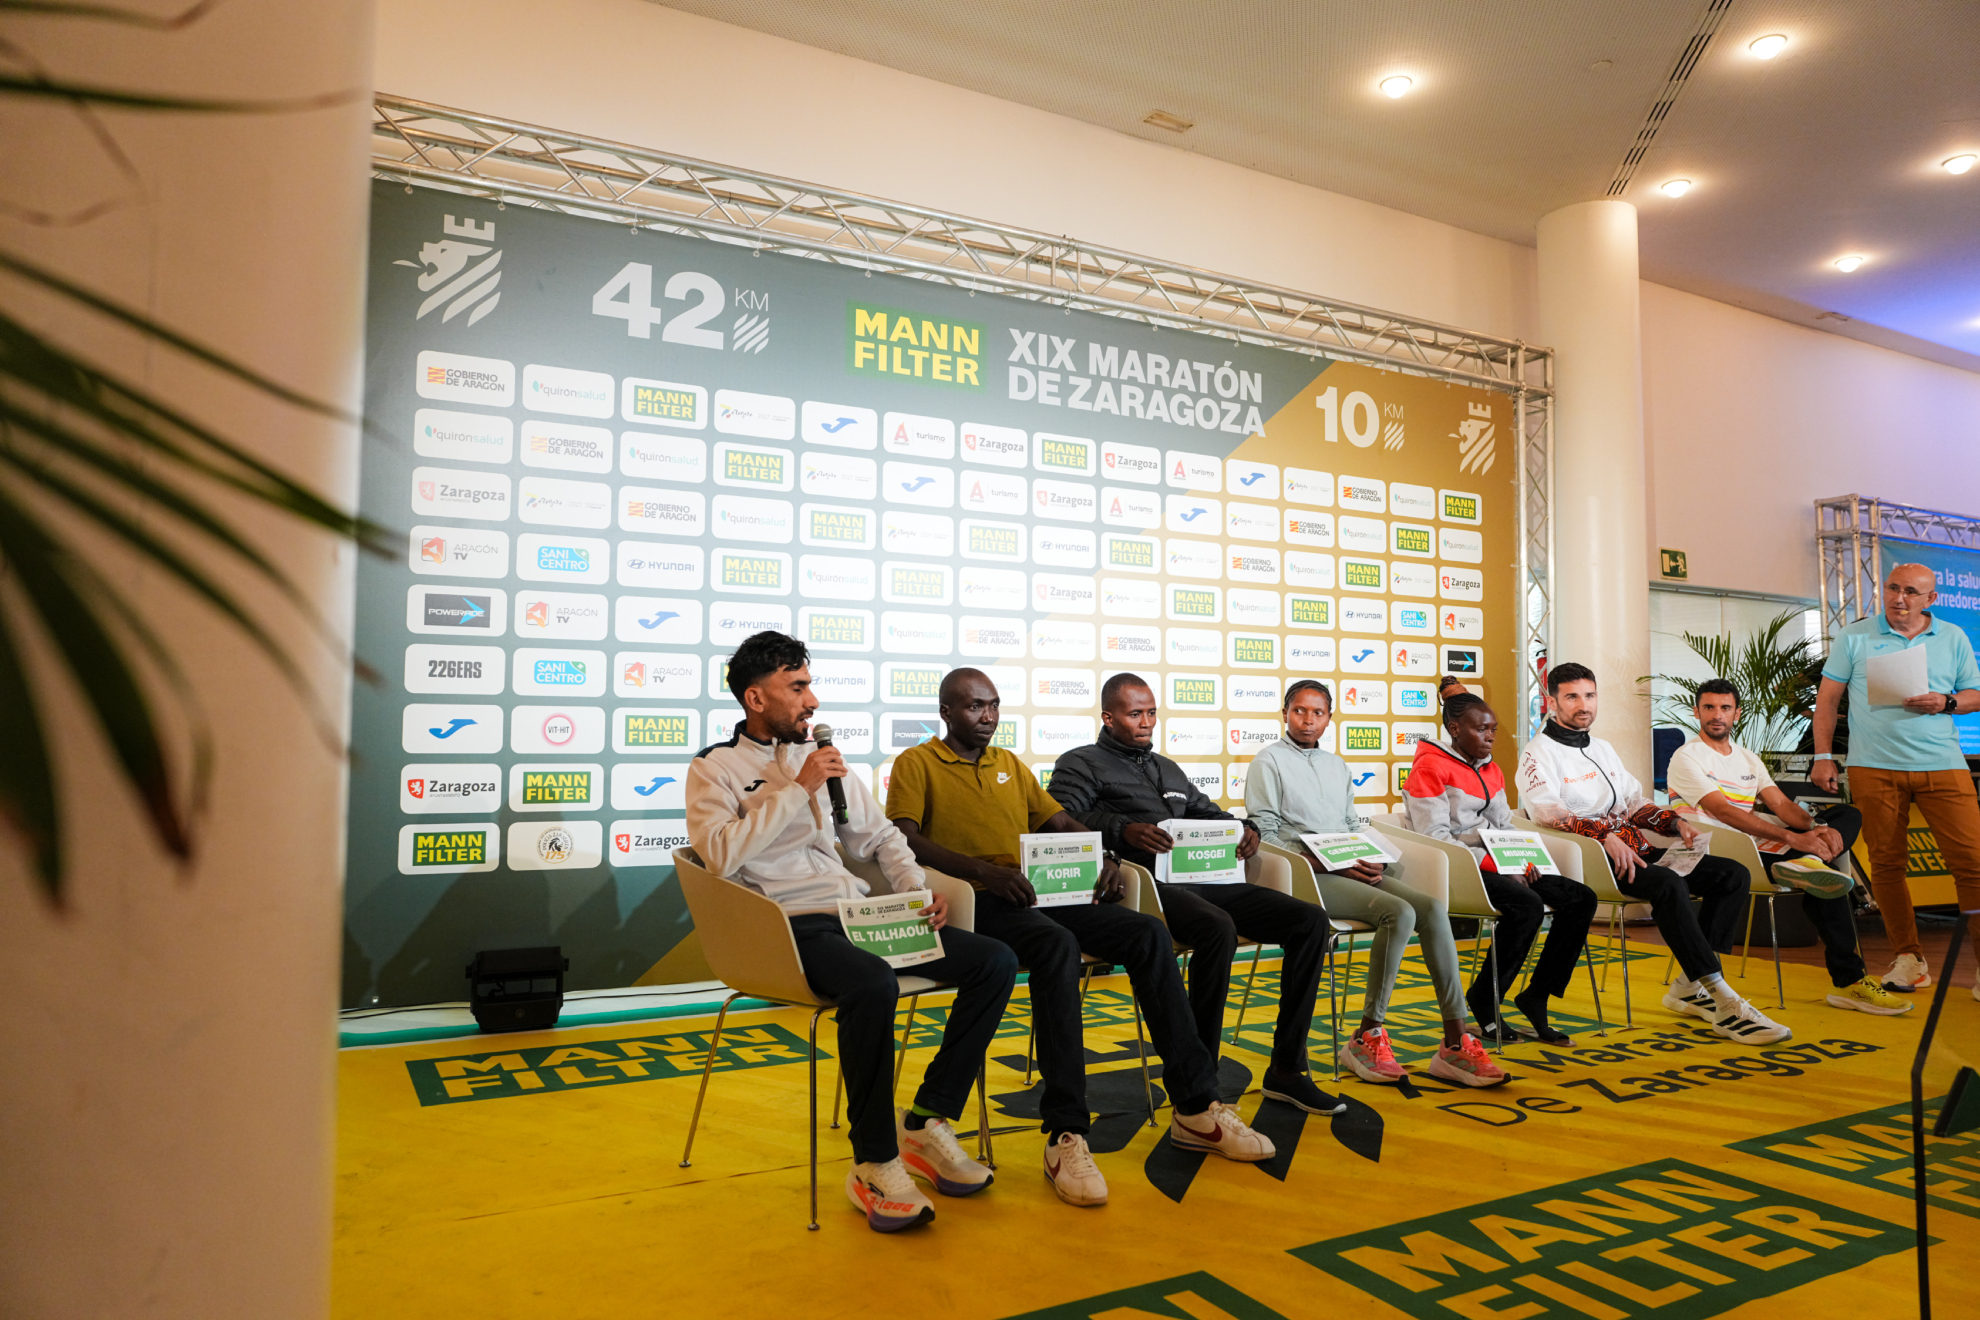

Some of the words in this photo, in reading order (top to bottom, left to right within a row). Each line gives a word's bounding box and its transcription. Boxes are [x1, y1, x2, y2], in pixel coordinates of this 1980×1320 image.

[592, 261, 725, 350] 42
[735, 287, 769, 312] KM
[855, 309, 979, 355] MANN
[854, 341, 979, 386] FILTER
[1008, 328, 1076, 371] XIX
[1089, 342, 1262, 404] MARATÓN
[446, 369, 498, 382] GOBIERNO
[446, 378, 460, 387] DE
[637, 388, 694, 406] MANN
[1009, 366, 1062, 403] DE
[1067, 373, 1266, 438] ZARAGOZA
[637, 401, 693, 419] FILTER
[1384, 402, 1404, 419] KM
[1316, 386, 1380, 448] 10
[917, 431, 945, 442] turismo
[548, 437, 597, 450] GOBIERNO
[979, 437, 1024, 453] Zaragoza
[1045, 441, 1085, 456] MANN
[548, 446, 561, 455] DE
[728, 452, 780, 468] MANN
[1044, 453, 1085, 468] FILTER
[1118, 455, 1158, 470] Zaragoza
[728, 465, 780, 481] FILTER
[440, 484, 505, 503] Zaragoza
[991, 488, 1018, 498] turismo
[1050, 492, 1092, 508] Zaragoza
[1447, 497, 1475, 509] MANN
[644, 502, 690, 513] GOBIERNO
[1129, 503, 1153, 513] turismo
[1447, 507, 1475, 518] FILTER
[644, 511, 656, 519] DE
[814, 513, 863, 528] MANN
[814, 526, 863, 541] FILTER
[972, 528, 1016, 541] MANN
[1399, 529, 1428, 542] MANN
[453, 543, 498, 554] ARAGÓN
[972, 540, 1016, 553] FILTER
[1055, 542, 1089, 553] HYUNDAI
[1112, 541, 1151, 554] MANN
[1399, 540, 1428, 551] FILTER
[453, 552, 468, 561] TV
[541, 548, 569, 560] SANI
[1112, 552, 1150, 565] FILTER
[540, 558, 588, 571] CENTRO
[648, 561, 695, 572] HYUNDAI
[726, 558, 778, 572] MANN
[1348, 564, 1378, 576] MANN
[726, 571, 778, 586] FILTER
[894, 572, 942, 585] MANN
[1348, 575, 1379, 587] FILTER
[1452, 577, 1480, 589] Zaragoza
[1945, 567, 1955, 587] la
[894, 583, 941, 596] FILTER
[1050, 587, 1092, 601] Zaragoza
[1176, 591, 1213, 604] MANN
[556, 606, 598, 618] ARAGÓN
[1176, 602, 1213, 615] FILTER
[1294, 600, 1326, 612] MANN
[556, 616, 570, 624] TV
[1294, 610, 1326, 622] FILTER
[1402, 611, 1416, 619] SANI
[739, 620, 783, 630] HYUNDAI
[812, 617, 861, 630] MANN
[1402, 619, 1426, 627] CENTRO
[812, 629, 861, 641] FILTER
[1237, 638, 1271, 651] MANN
[1237, 650, 1271, 661] FILTER
[428, 660, 482, 679] 226ERS
[538, 662, 566, 674] SANI
[537, 672, 585, 684] CENTRO
[824, 677, 866, 686] HYUNDAI
[894, 671, 940, 683] MANN
[893, 682, 940, 695] FILTER
[1176, 680, 1213, 692] MANN
[1176, 691, 1213, 703] FILTER
[1402, 691, 1417, 699] SANI
[1402, 699, 1427, 708] CENTRO
[629, 718, 685, 731] MANN
[629, 731, 685, 744] FILTER
[833, 727, 869, 739] ragoza
[1242, 731, 1278, 742] Zaragoza
[1349, 727, 1379, 739] MANN
[1349, 738, 1379, 749] FILTER
[527, 774, 587, 787] MANN
[1187, 775, 1220, 788] aragoza
[429, 780, 496, 797] Zaragoza
[527, 788, 587, 801] FILTER
[417, 834, 482, 848] MANN
[417, 848, 482, 863] FILTER
[545, 850, 565, 860] 175
[1043, 847, 1054, 855] 42
[1187, 849, 1226, 860] KOSGEI
[1046, 867, 1081, 880] KORIR
[859, 907, 871, 916] 42
[852, 931, 866, 942] EL
[867, 924, 930, 942] TALHAOUI
[887, 944, 892, 952] 1
[435, 1028, 788, 1078] MANN
[442, 1043, 808, 1098] FILTER
[1435, 1097, 1582, 1127] De
[1556, 1038, 1885, 1104] Zaragoza
[1337, 1168, 1761, 1293] MANN
[1436, 1205, 1885, 1320] FILTER
